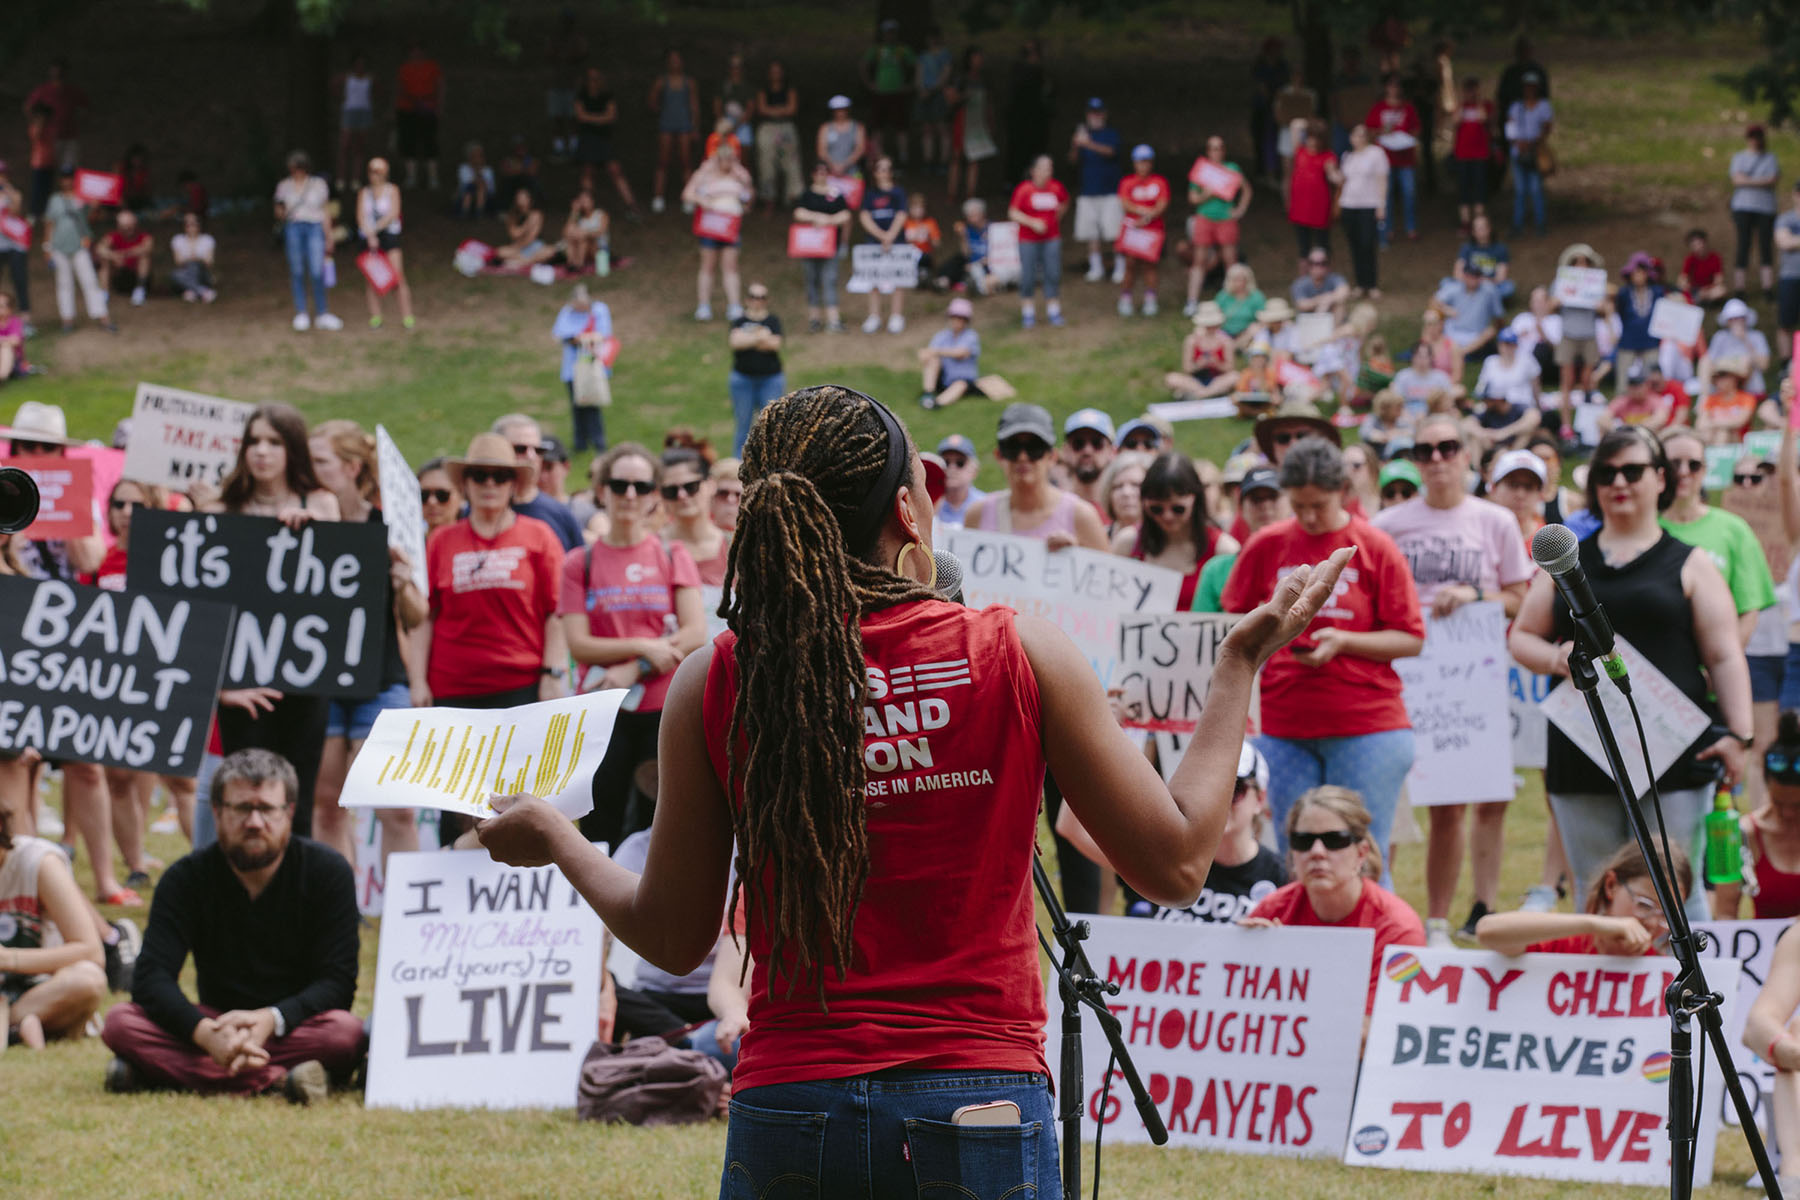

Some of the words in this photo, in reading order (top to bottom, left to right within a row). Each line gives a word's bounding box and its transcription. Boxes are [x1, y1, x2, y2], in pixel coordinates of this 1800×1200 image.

[168, 458, 207, 480] NOT
[160, 515, 231, 588] it's
[266, 526, 361, 598] the
[1043, 550, 1152, 610] EVERY
[22, 579, 190, 664] BAN
[229, 607, 366, 687] NS!
[1120, 616, 1180, 667] IT'S
[1190, 619, 1235, 667] TH
[0, 700, 192, 766] EAPONS!
[864, 697, 951, 738] AND
[865, 779, 889, 797] SE
[891, 777, 910, 795] IN
[915, 768, 994, 793] AMERICA
[404, 881, 443, 915] I
[540, 947, 572, 979] to
[1107, 955, 1206, 997] MORE
[1223, 963, 1311, 1002] THAN
[1398, 964, 1525, 1012] MY
[404, 982, 573, 1058] LIVE
[1393, 1023, 1636, 1076] DESERVES
[1143, 1072, 1319, 1147] PRAYERS
[1392, 1101, 1472, 1151] TO
[1495, 1103, 1672, 1167] LIVE
